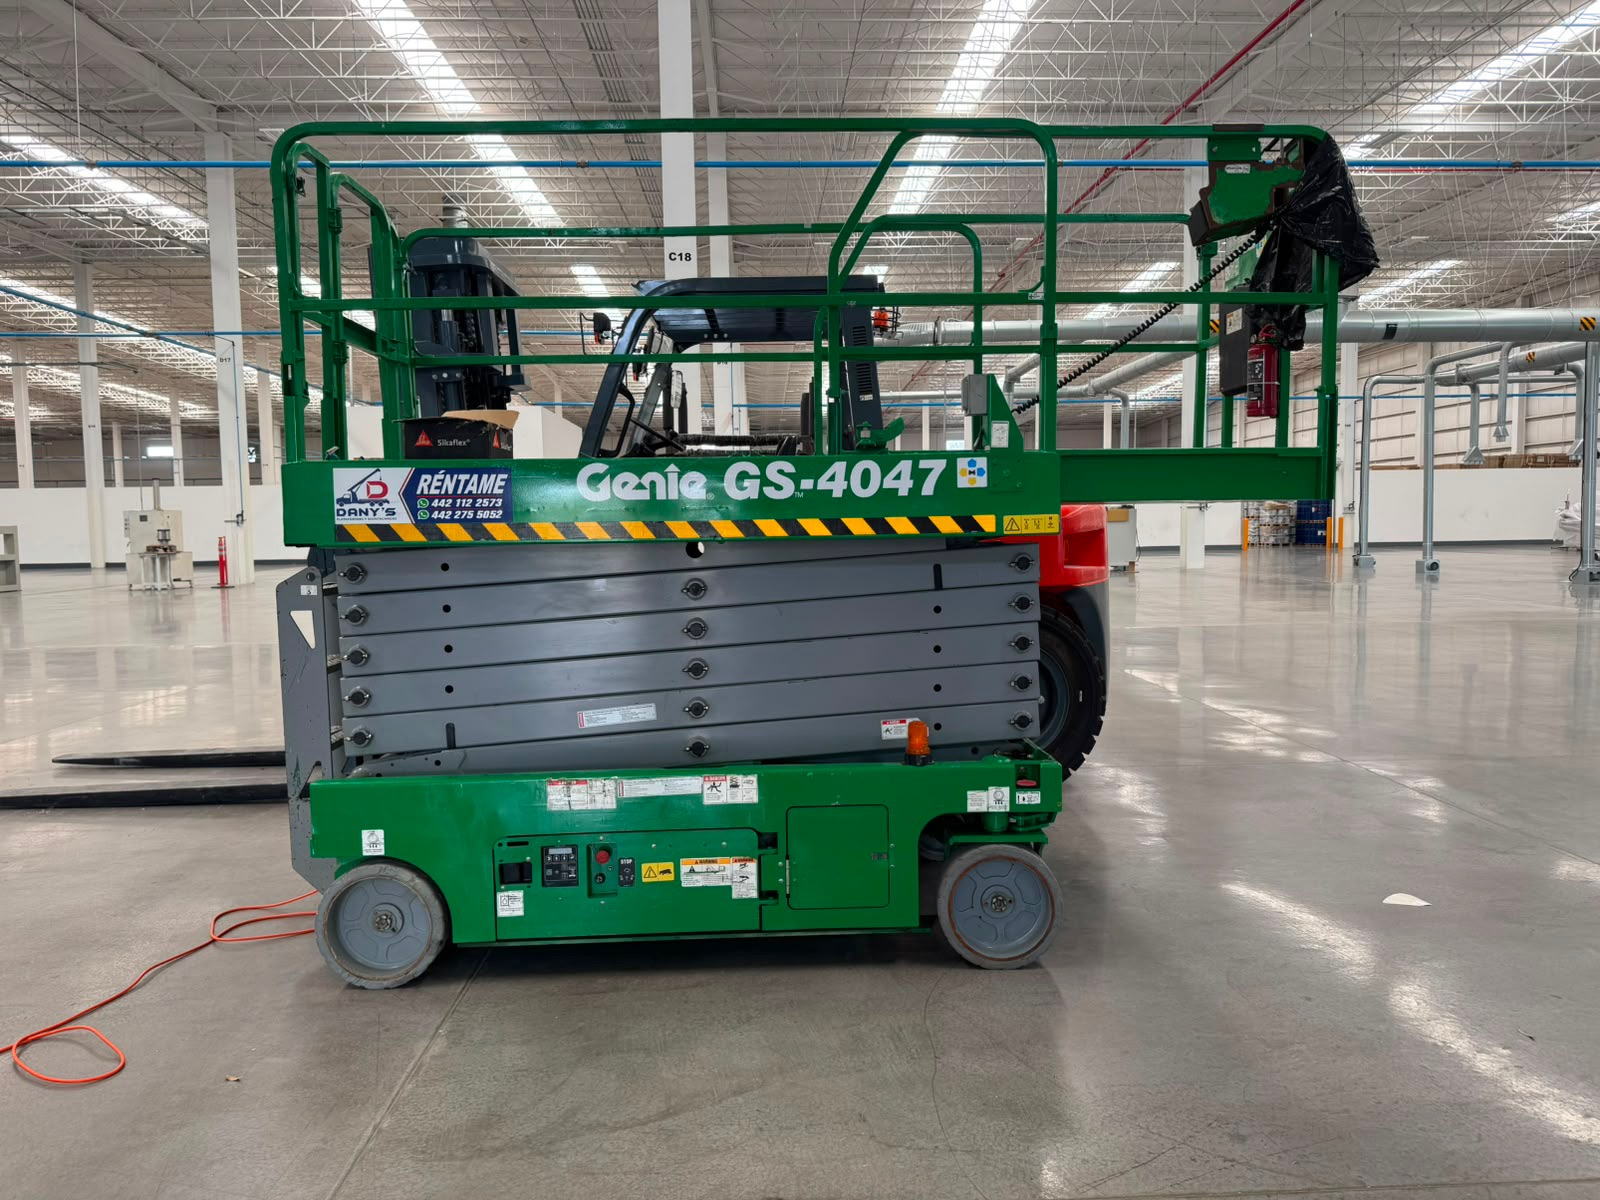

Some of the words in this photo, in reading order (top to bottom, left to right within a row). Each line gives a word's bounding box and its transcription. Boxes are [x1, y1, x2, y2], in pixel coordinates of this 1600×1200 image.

[668, 251, 692, 262] C18
[416, 470, 508, 495] RÉNTAME
[723, 459, 947, 501] GS-4047
[431, 498, 453, 508] 442
[455, 498, 473, 508] 112
[475, 498, 503, 508] 2573
[336, 507, 397, 517] DANY'S
[431, 510, 452, 520] 442
[454, 510, 474, 519] 275
[476, 509, 503, 519] 5052
